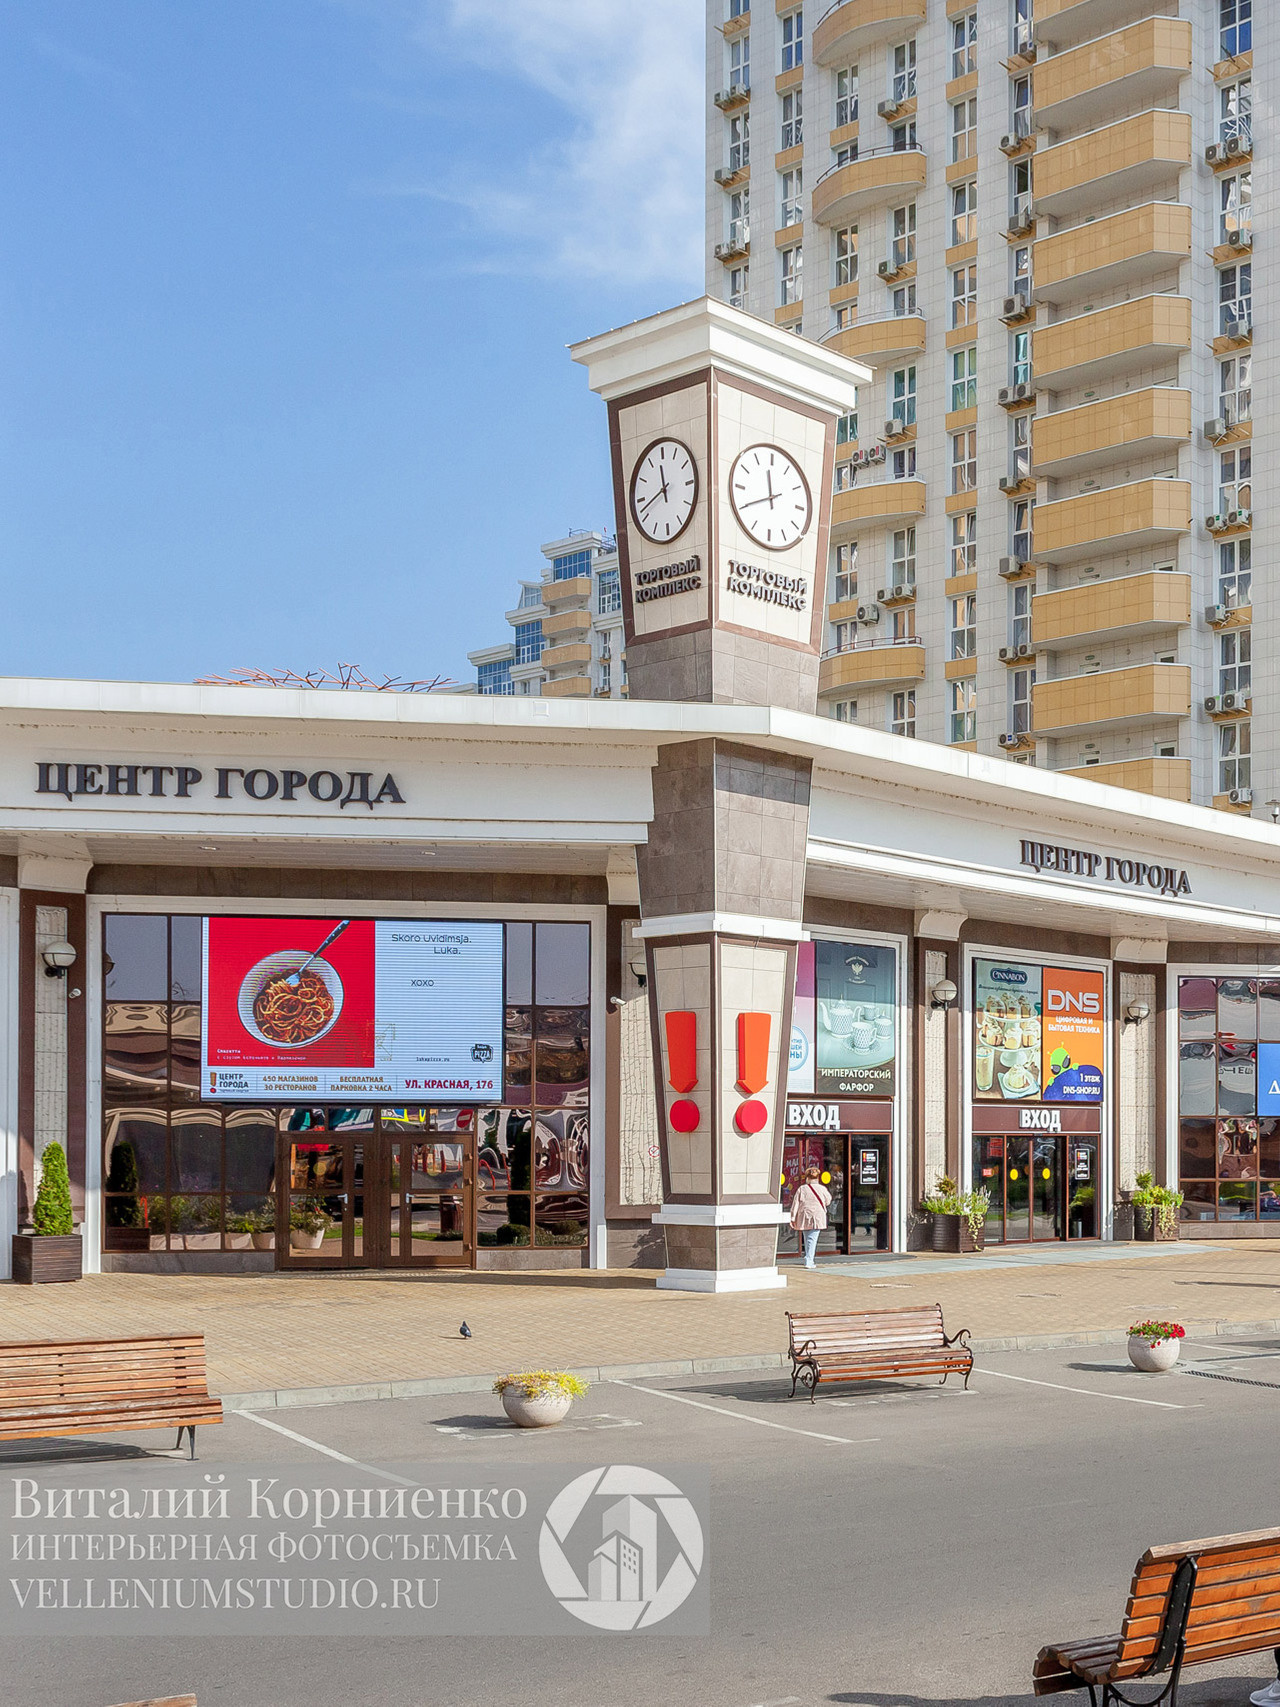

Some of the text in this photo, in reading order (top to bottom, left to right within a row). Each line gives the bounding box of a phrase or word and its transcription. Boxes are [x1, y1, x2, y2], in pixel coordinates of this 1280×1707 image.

[635, 554, 700, 585] ТОРГОВЫЙ
[728, 560, 808, 594] ТОРГОВЫЙ
[636, 576, 701, 603] КОМПЛЕКС
[727, 577, 806, 612] КОМПЛЕКС
[34, 762, 406, 810] ЦЕНТР ГОРОДА
[1019, 840, 1192, 897] ЦЕНТР ГОРОДА
[1048, 990, 1100, 1014] DNS
[1048, 1024, 1100, 1034] БЫТОВАЯ ТЕХНИКА
[1056, 1016, 1087, 1024] ЦИФРОВАЯ
[219, 1073, 244, 1081] ЦЕНТР
[822, 1069, 892, 1079] ИМПЕРАТОРСКИЙ
[1080, 1073, 1084, 1082] 1
[405, 1080, 493, 1091] УЛ. КРАСНАЯ, 176
[840, 1082, 874, 1092] ФАРФОР
[1063, 1086, 1100, 1094] DNS-SHOP.RU
[788, 1104, 840, 1130] ВХОД
[1020, 1110, 1061, 1132] ВХОД
